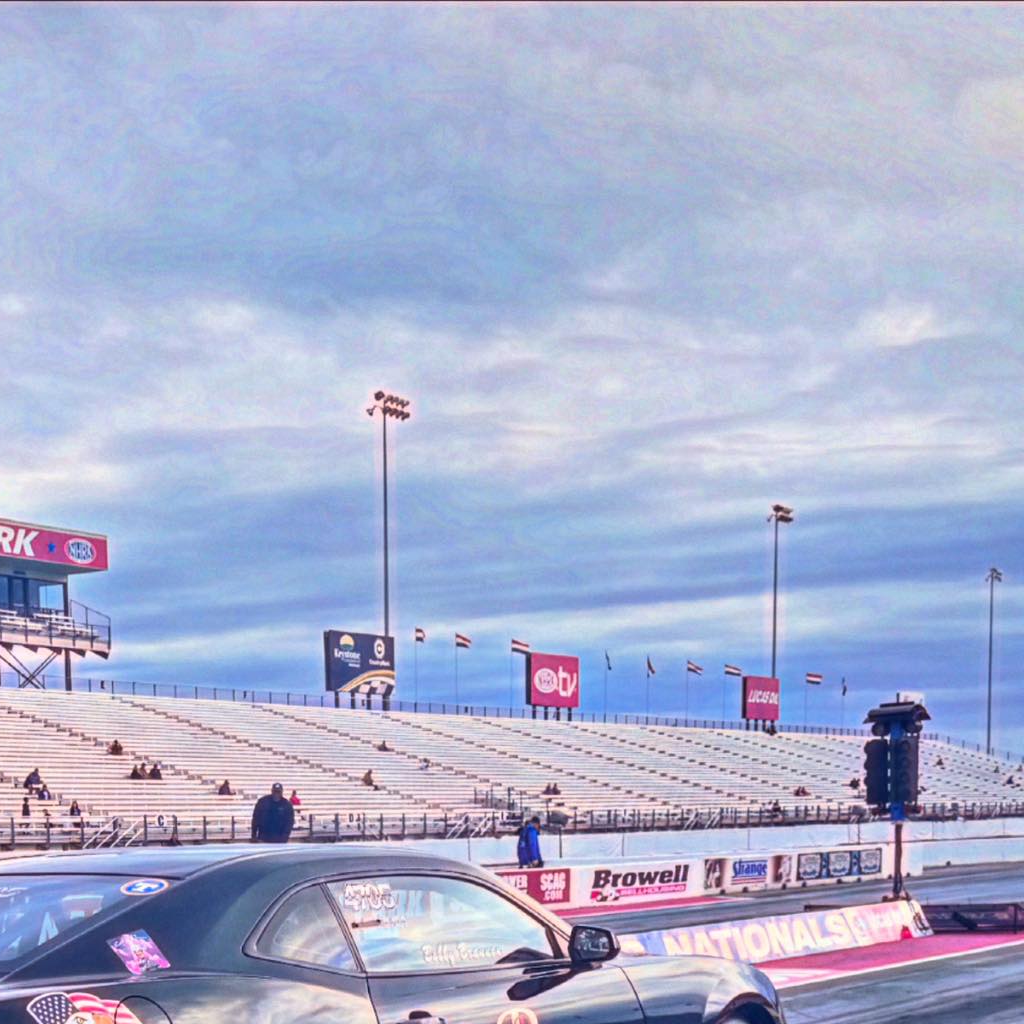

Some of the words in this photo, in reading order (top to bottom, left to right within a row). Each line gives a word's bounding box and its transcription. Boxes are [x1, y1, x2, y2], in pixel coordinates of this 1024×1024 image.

[557, 665, 577, 698] tv
[747, 689, 767, 703] LUCAS
[157, 814, 165, 827] C
[592, 864, 689, 888] Browell
[732, 858, 768, 878] Strange
[540, 872, 566, 891] SCAG
[662, 910, 849, 961] NATIONALS
